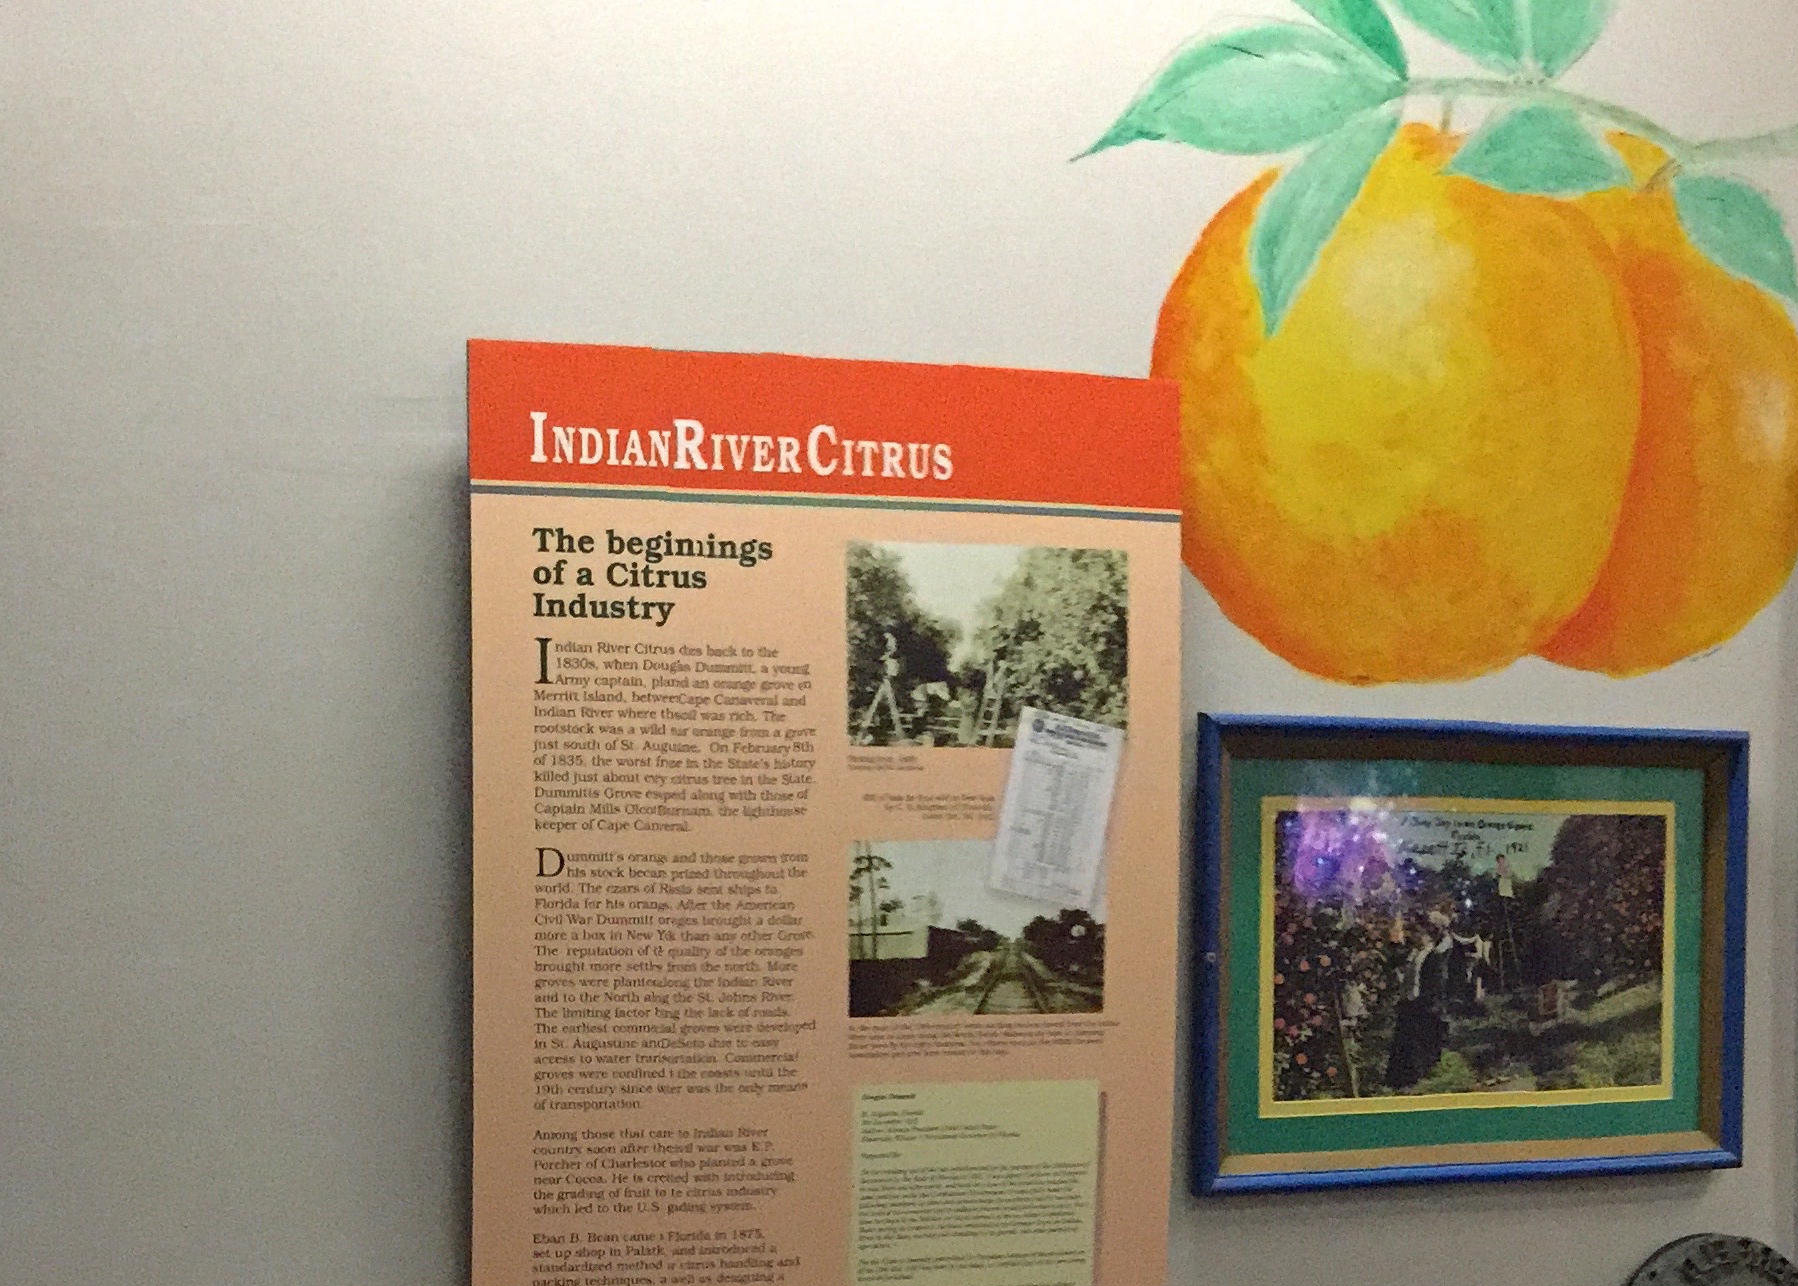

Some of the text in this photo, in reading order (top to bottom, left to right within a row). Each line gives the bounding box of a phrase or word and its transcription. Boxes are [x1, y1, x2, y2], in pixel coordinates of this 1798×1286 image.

[532, 528, 596, 555] The
[533, 560, 707, 590] of a Citrus
[533, 593, 675, 626] Industry
